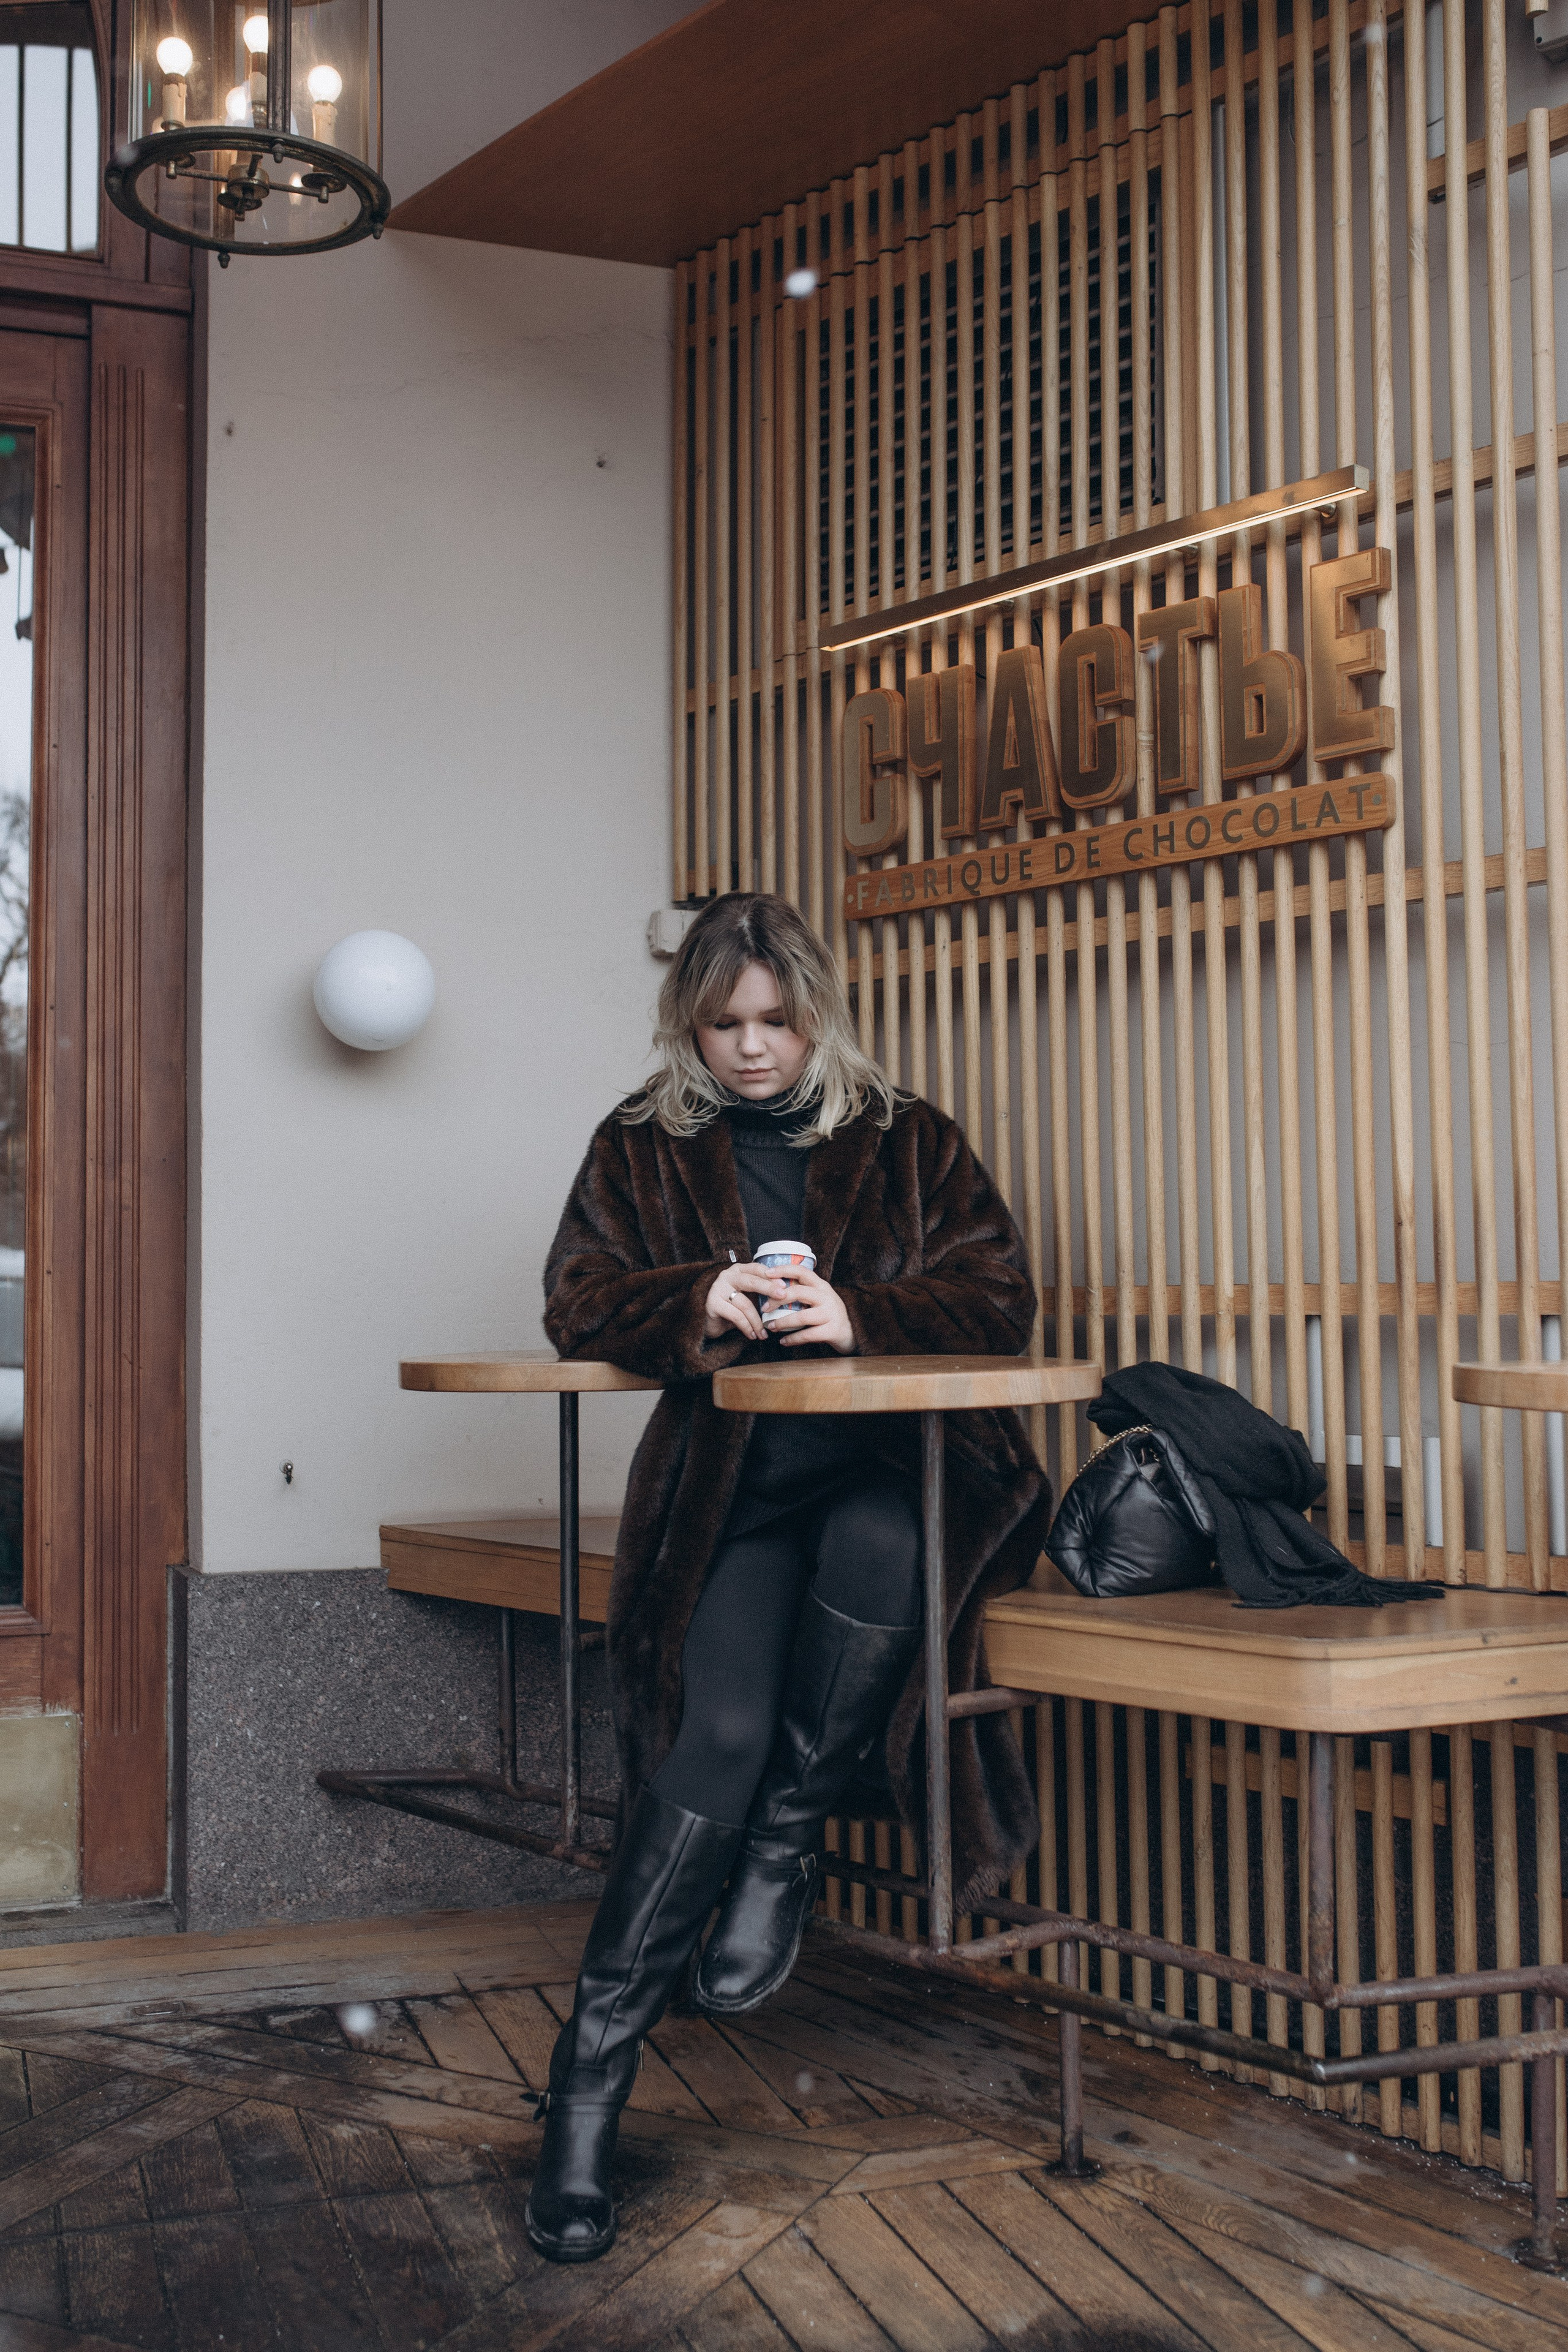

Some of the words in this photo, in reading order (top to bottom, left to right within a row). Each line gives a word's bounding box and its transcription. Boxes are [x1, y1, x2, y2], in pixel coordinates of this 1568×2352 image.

[842, 546, 1395, 856] СЧАСТЬЕ
[856, 848, 1033, 910] FABRIQUE
[1054, 835, 1101, 875] DE
[1123, 783, 1371, 861] CHOCOLAT
